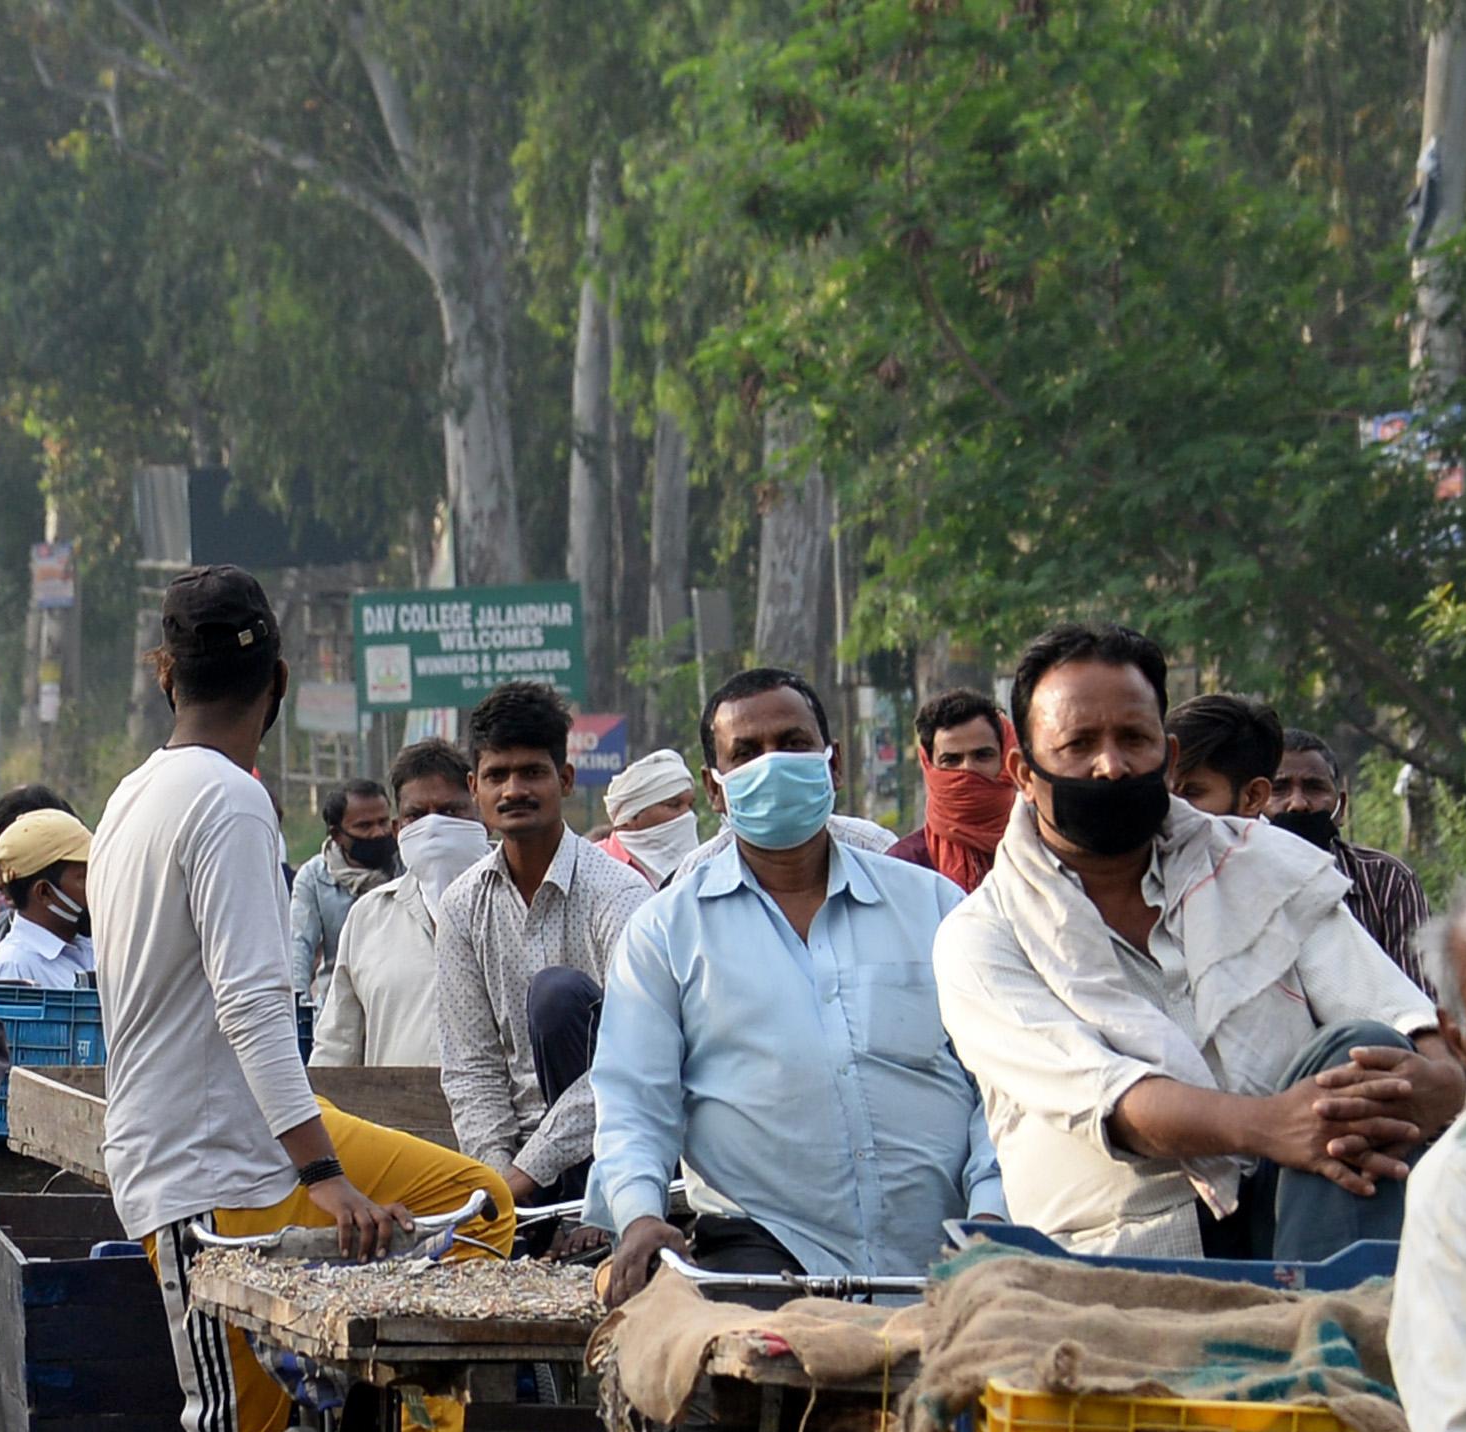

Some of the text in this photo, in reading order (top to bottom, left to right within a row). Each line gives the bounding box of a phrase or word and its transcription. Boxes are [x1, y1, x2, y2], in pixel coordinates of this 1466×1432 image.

[362, 601, 573, 635] DAV COLLEGE JALANDHAR
[438, 627, 545, 651] WELCOMES
[414, 654, 479, 676] WINNERS
[481, 653, 492, 672] &
[495, 650, 571, 672] ACHIEVERS
[567, 731, 599, 751] NO
